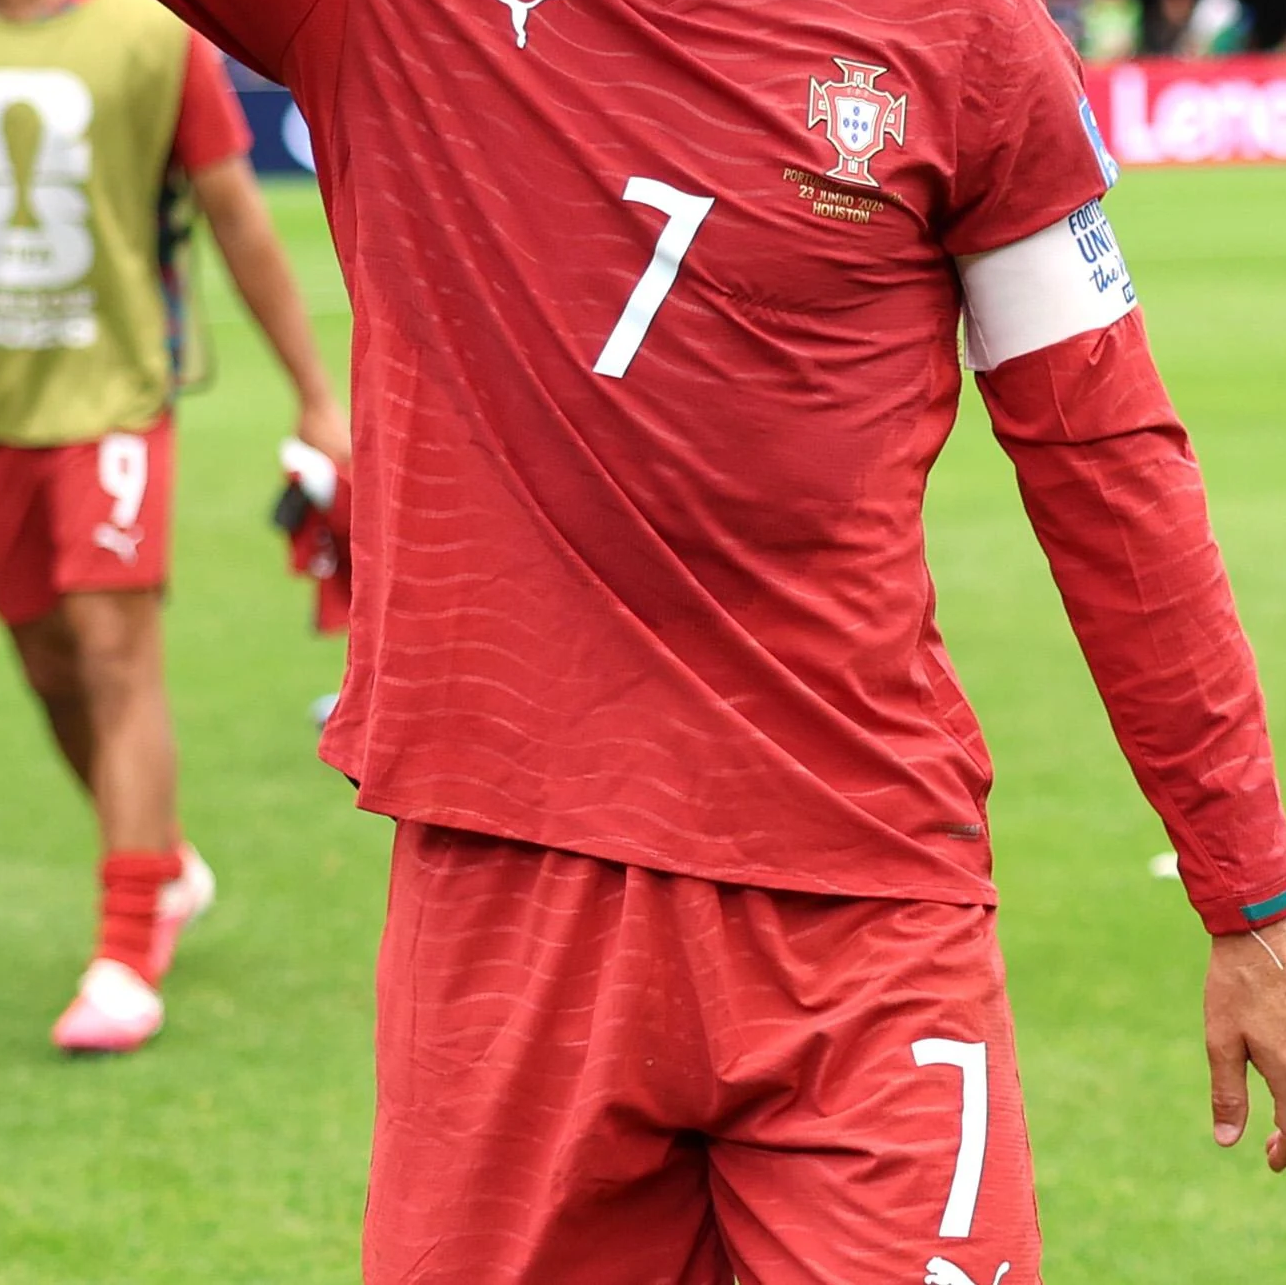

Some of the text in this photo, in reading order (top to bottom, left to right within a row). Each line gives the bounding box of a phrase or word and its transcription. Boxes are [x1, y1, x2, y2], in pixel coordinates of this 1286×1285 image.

[798, 184, 815, 200] 23
[816, 190, 854, 208] JUNHO
[858, 197, 884, 213] 2026
[812, 201, 870, 224] HOUSTON
[592, 176, 715, 379] 7
[1089, 263, 1119, 293] the
[99, 433, 148, 527] 9
[910, 1037, 987, 1239] 7
